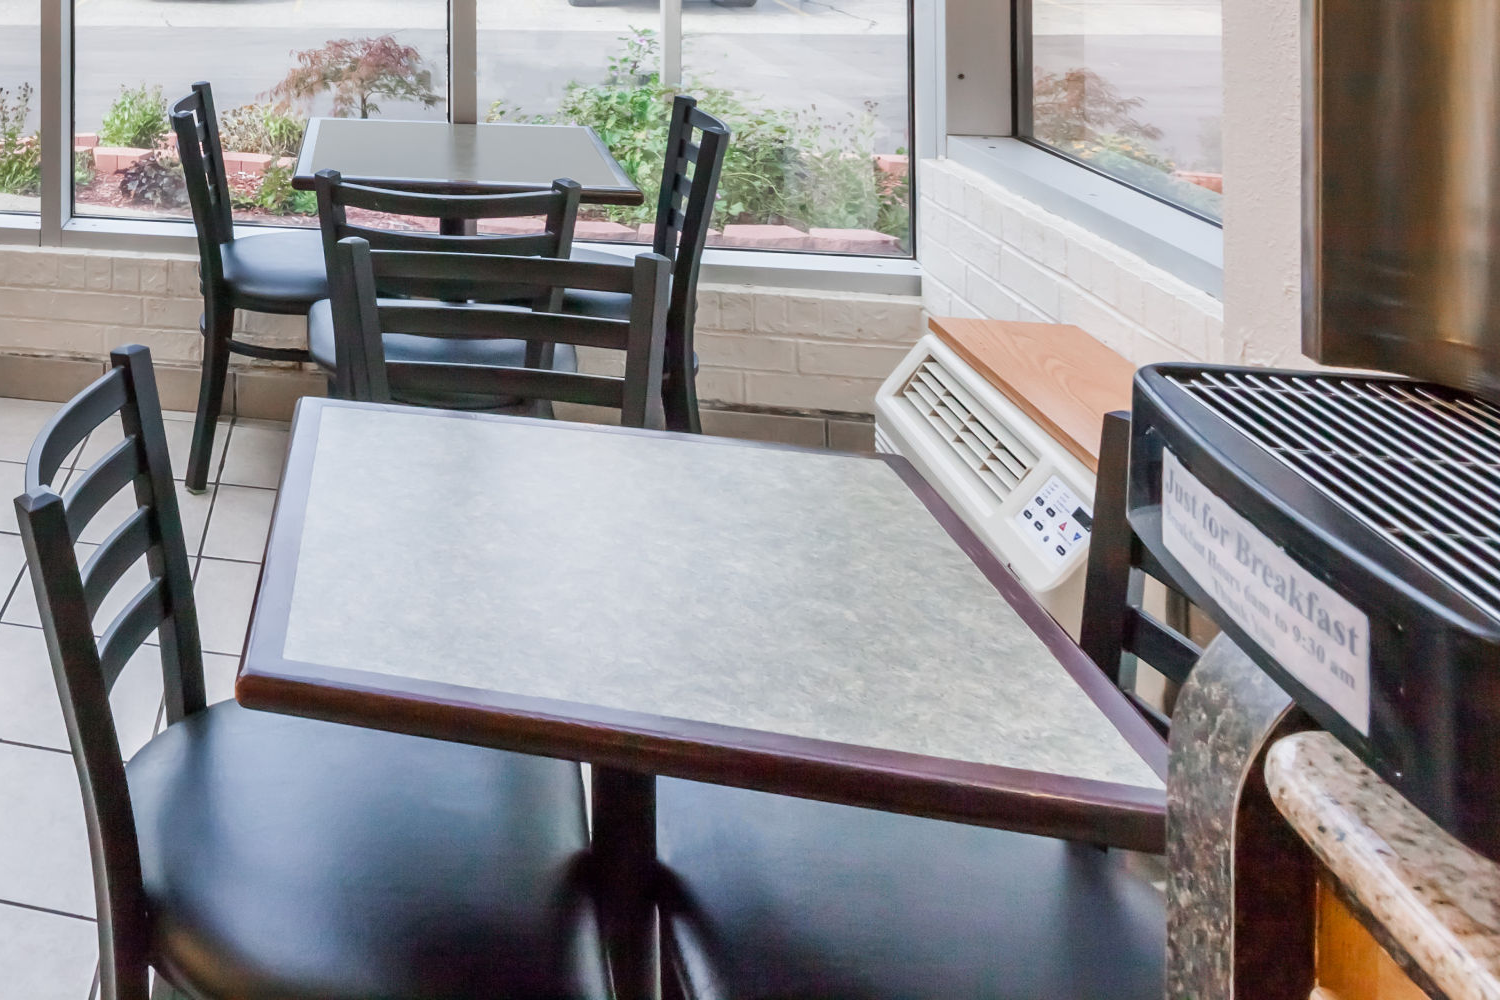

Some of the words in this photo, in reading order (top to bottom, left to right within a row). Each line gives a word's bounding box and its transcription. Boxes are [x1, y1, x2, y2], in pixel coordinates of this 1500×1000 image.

[1165, 468, 1197, 520] Just
[1202, 503, 1229, 548] for
[1236, 530, 1359, 656] Breakfast
[1275, 613, 1288, 634] to
[1293, 625, 1325, 664] 9:30
[1330, 661, 1356, 690] am
